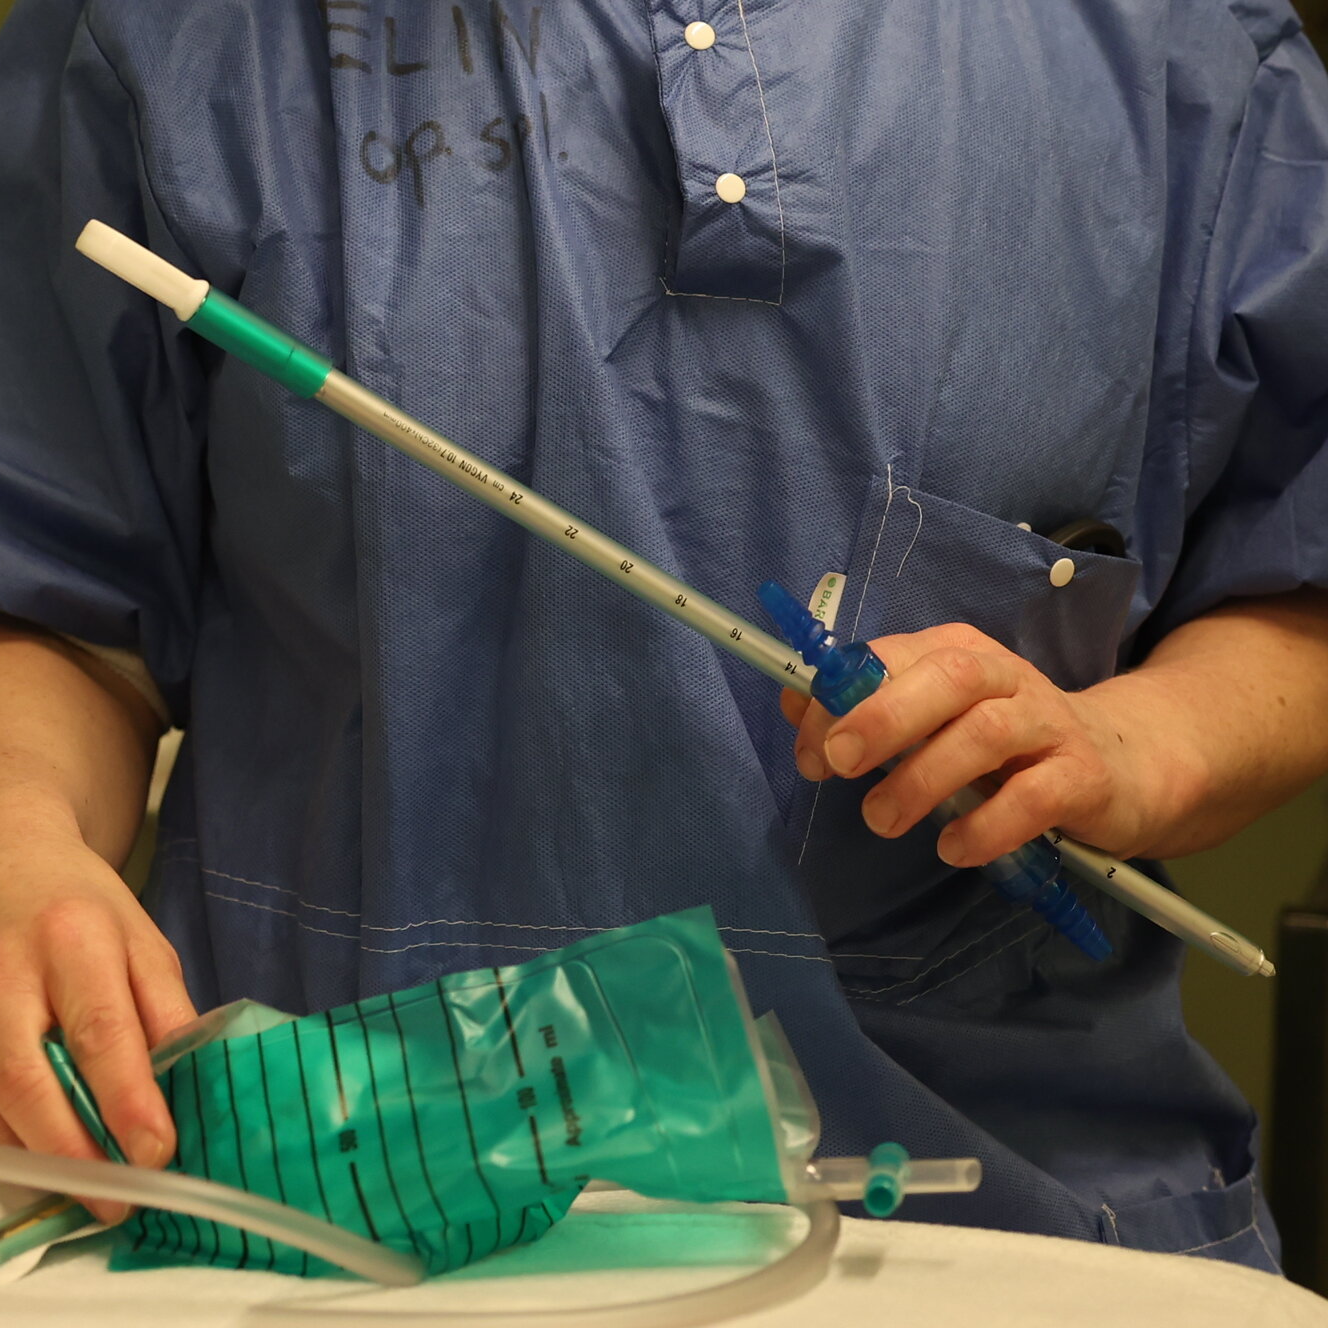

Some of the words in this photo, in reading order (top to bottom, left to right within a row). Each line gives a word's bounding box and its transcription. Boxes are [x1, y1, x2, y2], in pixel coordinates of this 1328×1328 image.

[458, 459, 488, 484] VYGON
[509, 491, 524, 505] 24
[564, 524, 579, 540] 22
[619, 559, 634, 575] 20
[674, 593, 688, 609] 18
[729, 627, 743, 642] 16
[784, 661, 798, 676] 14
[1106, 866, 1117, 879] 2
[538, 1024, 558, 1049] ml
